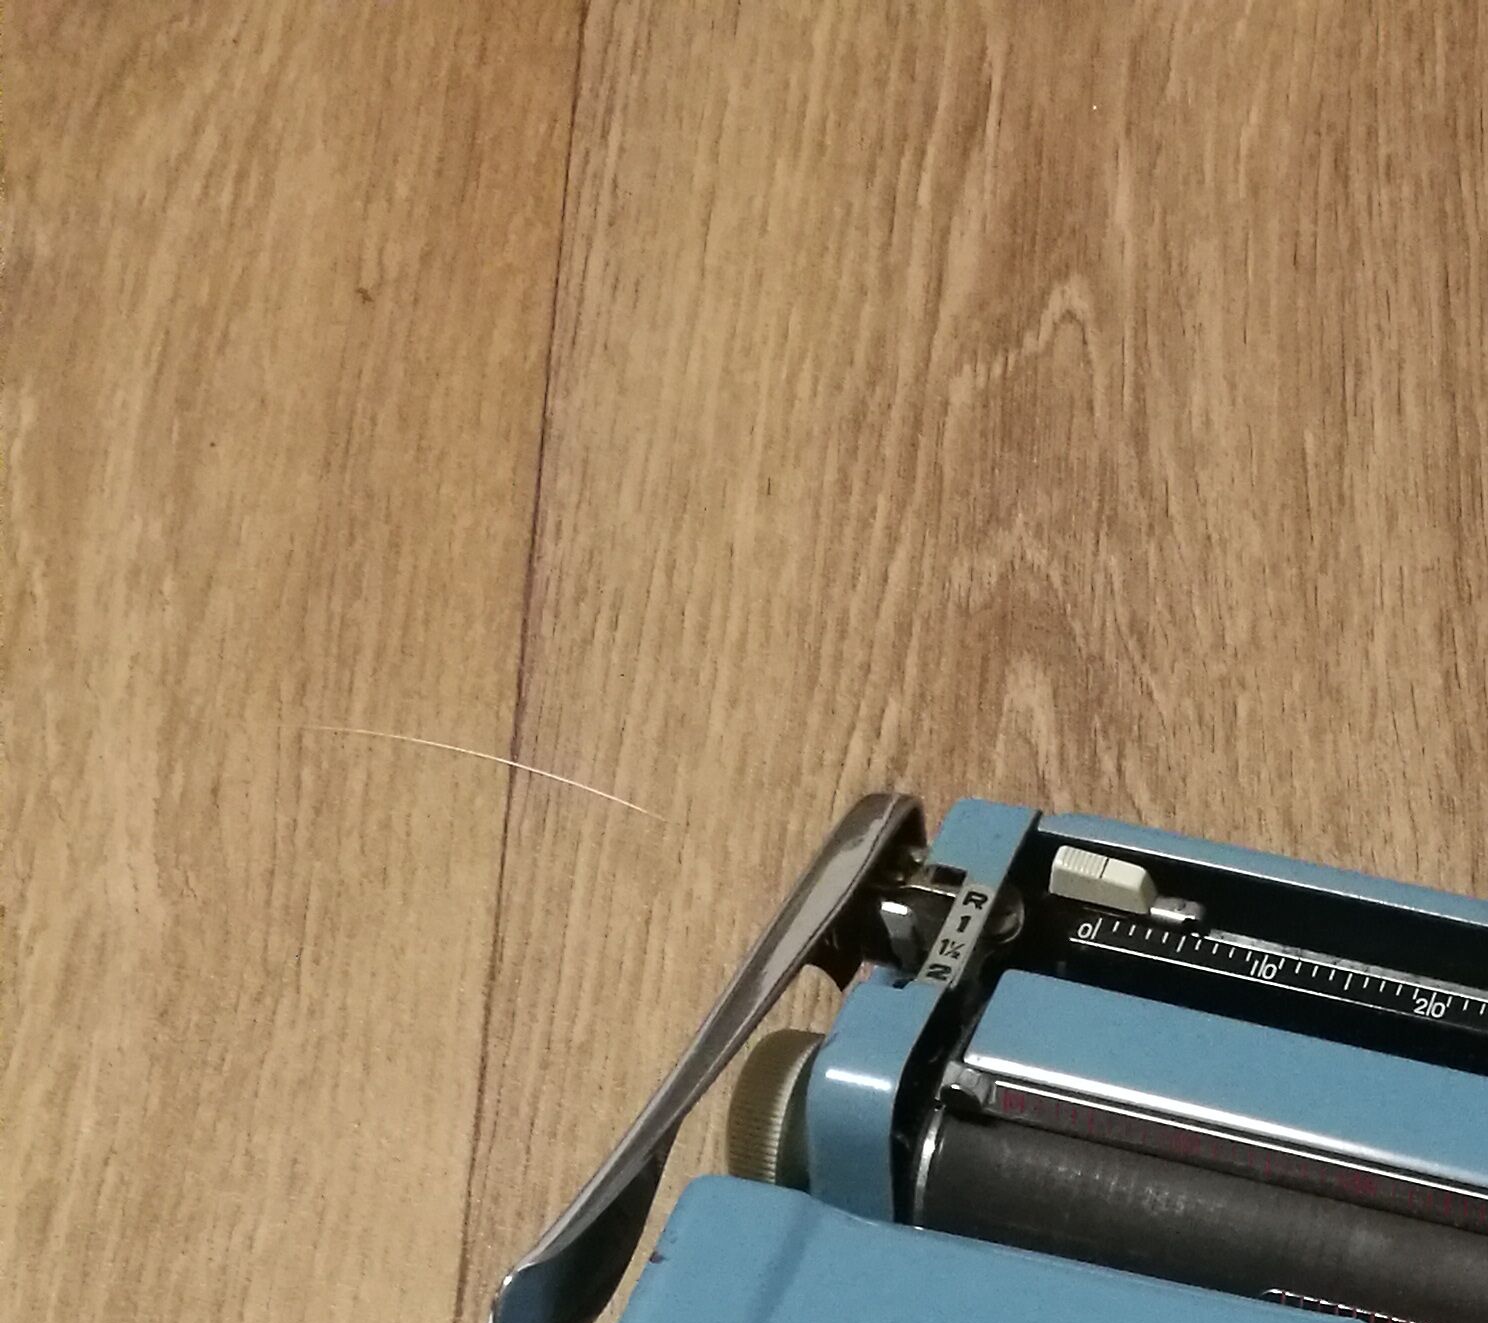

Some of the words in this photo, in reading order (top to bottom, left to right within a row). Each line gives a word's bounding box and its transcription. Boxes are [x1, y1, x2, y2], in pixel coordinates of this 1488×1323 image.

[963, 891, 988, 910] R
[957, 915, 971, 933] 1
[1077, 922, 1093, 940] 0
[926, 963, 951, 980] 2
[1414, 996, 1447, 1019] 20
